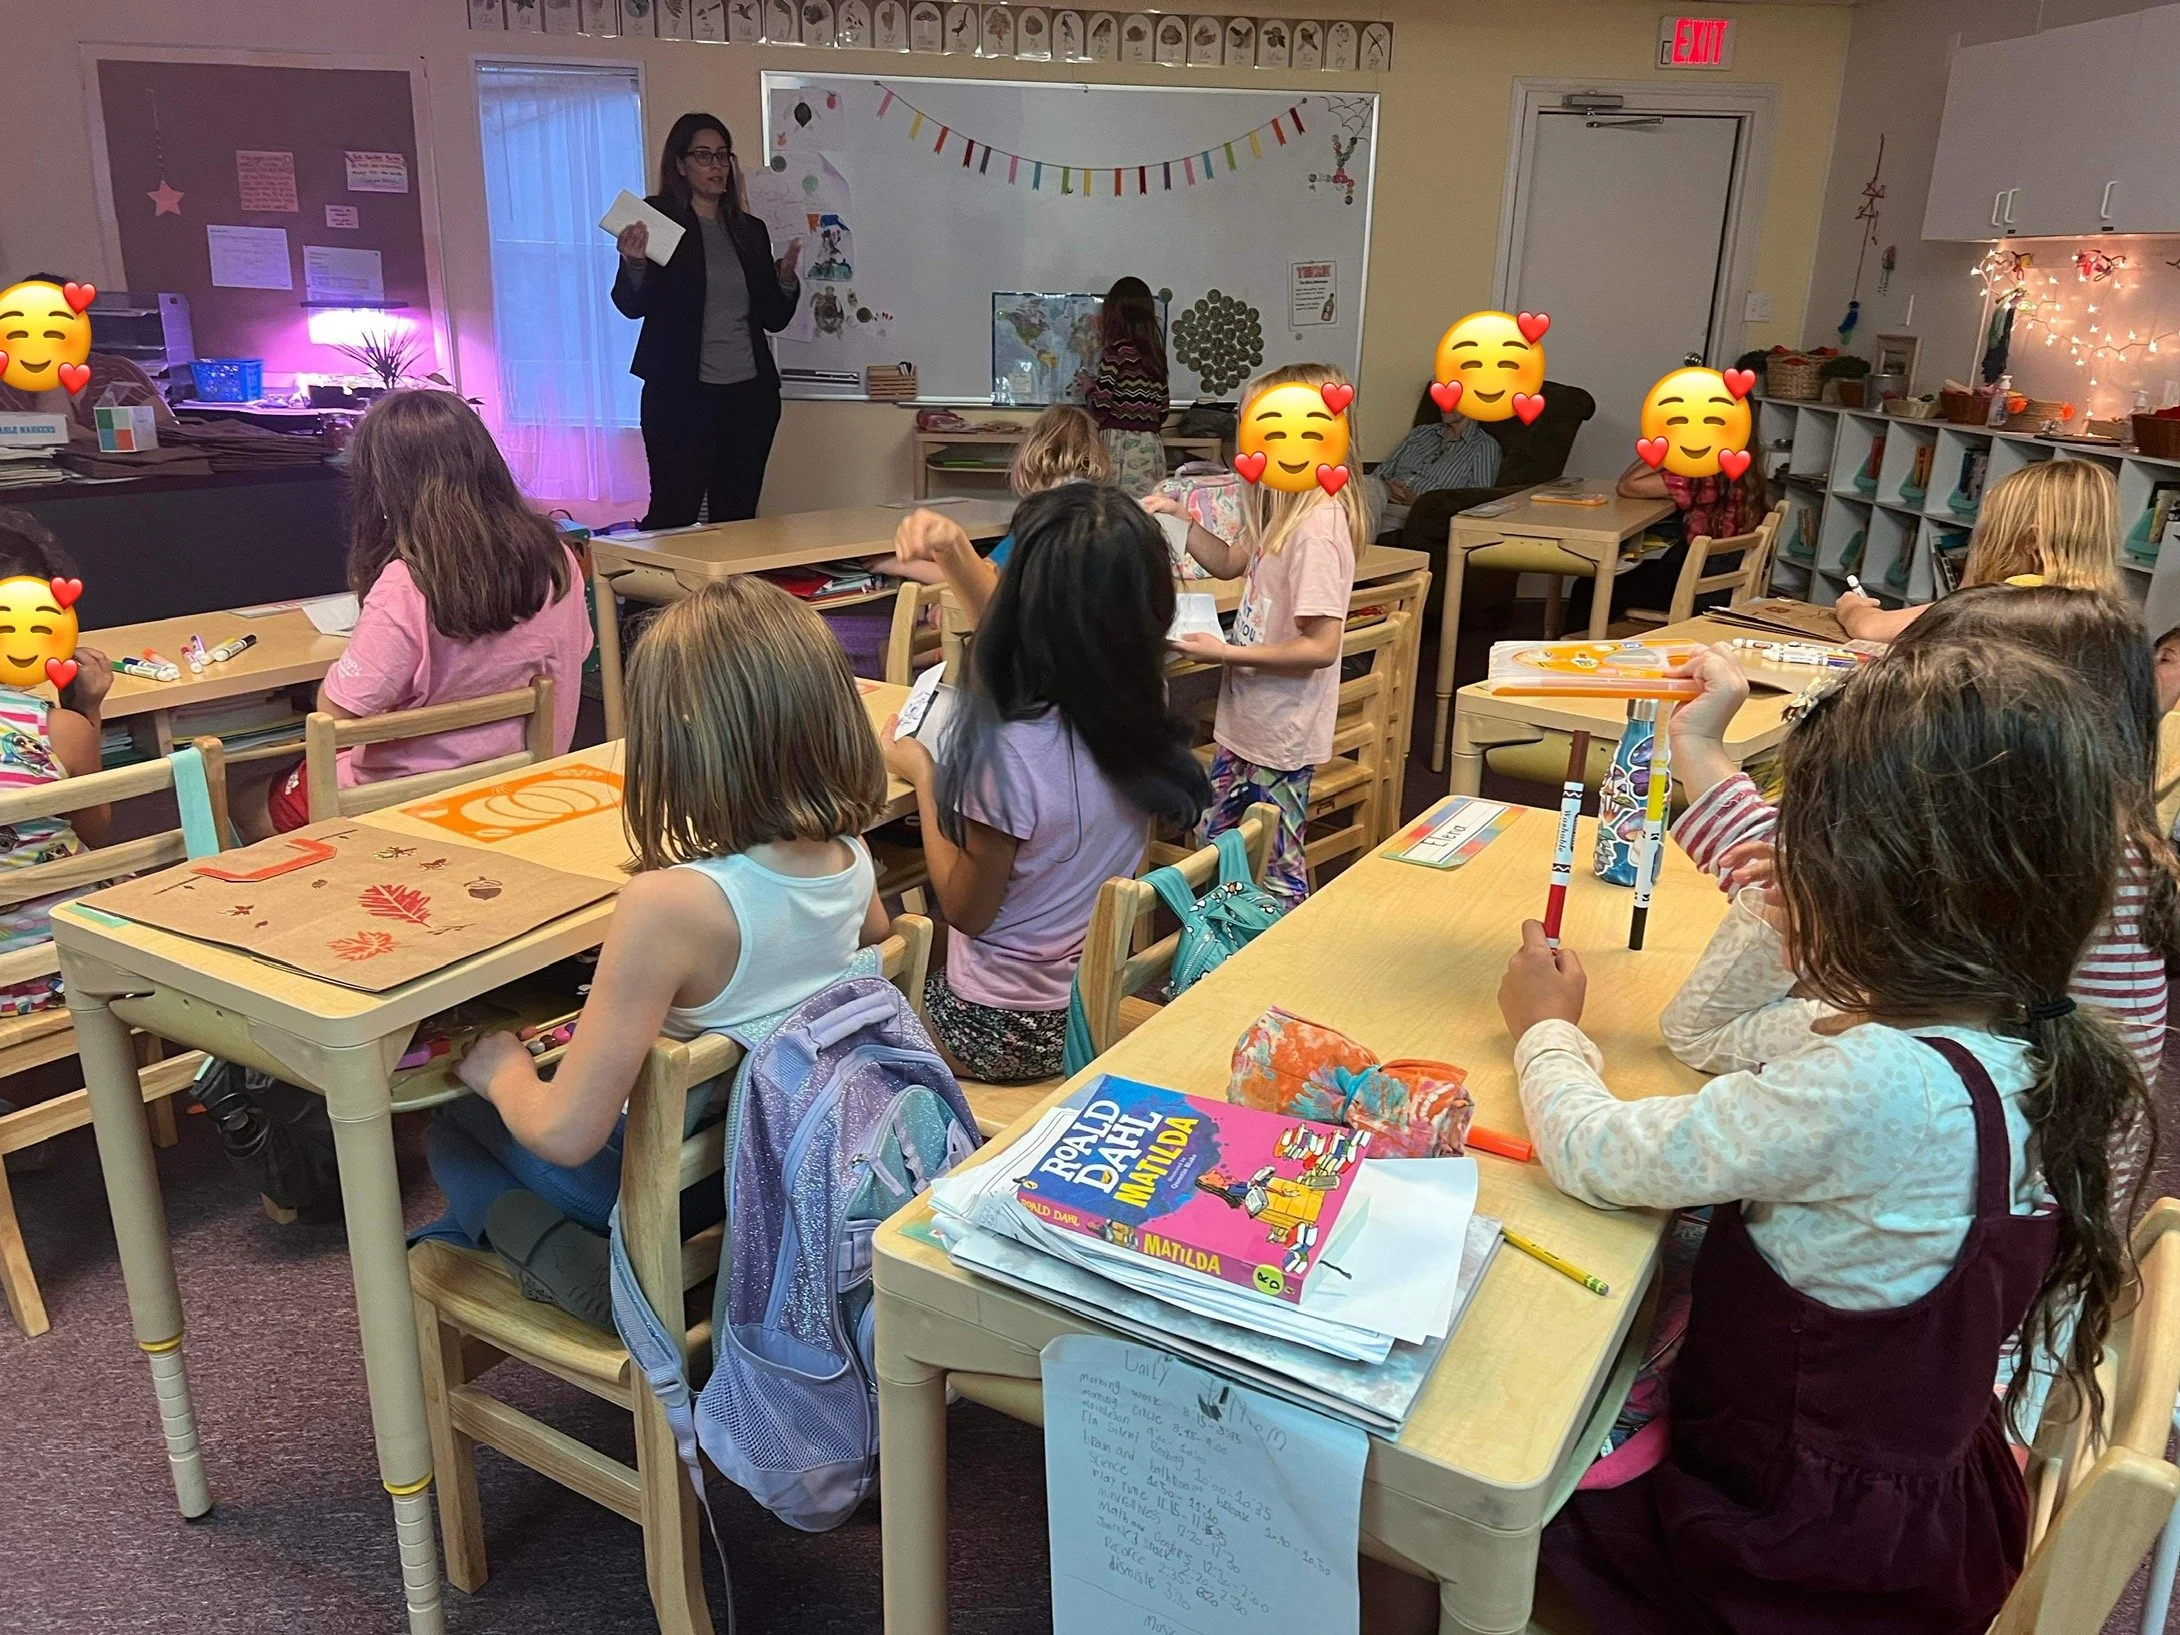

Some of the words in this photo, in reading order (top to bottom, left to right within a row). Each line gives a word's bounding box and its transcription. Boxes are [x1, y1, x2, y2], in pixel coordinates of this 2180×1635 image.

[1672, 17, 1728, 65] EXIT
[1558, 810, 1572, 853] Washable
[1039, 1099, 1121, 1183] ROALD
[1073, 1110, 1164, 1194] DAHL
[1113, 1115, 1199, 1209] MATILDA
[1171, 1168, 1188, 1189] Quentin
[1184, 1154, 1197, 1168] Blake
[1053, 1209, 1080, 1227] DAHL
[1143, 1234, 1221, 1276] MATILDA
